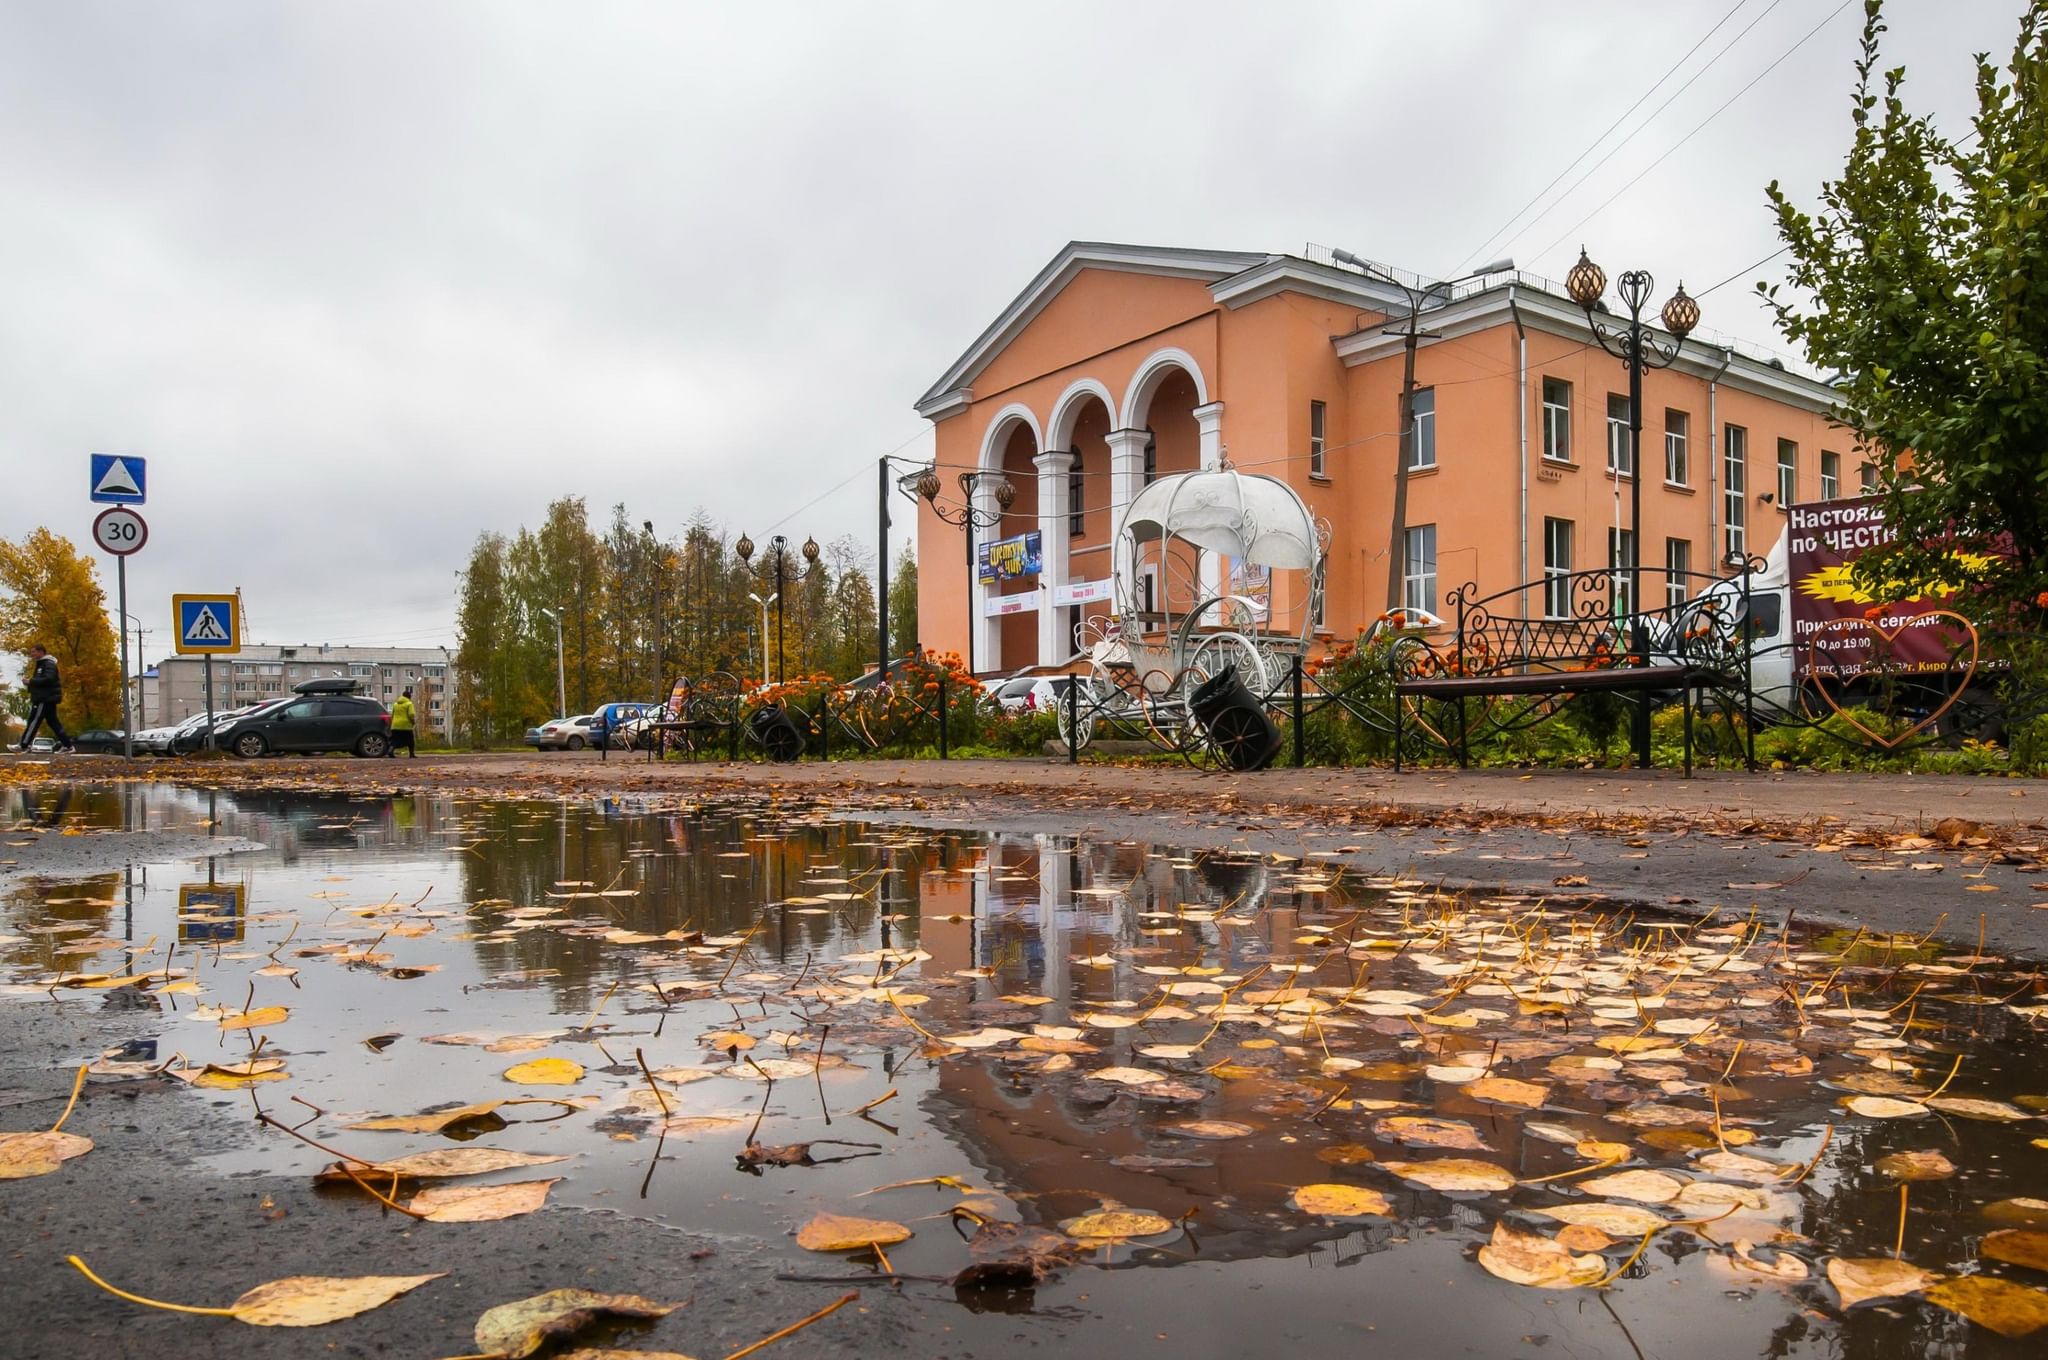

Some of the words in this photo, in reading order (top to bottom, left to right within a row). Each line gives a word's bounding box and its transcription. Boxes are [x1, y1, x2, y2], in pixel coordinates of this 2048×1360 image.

[107, 522, 137, 541] 30
[1792, 537, 1817, 554] по
[1829, 640, 1841, 650] до
[1843, 636, 1871, 649] 19.00
